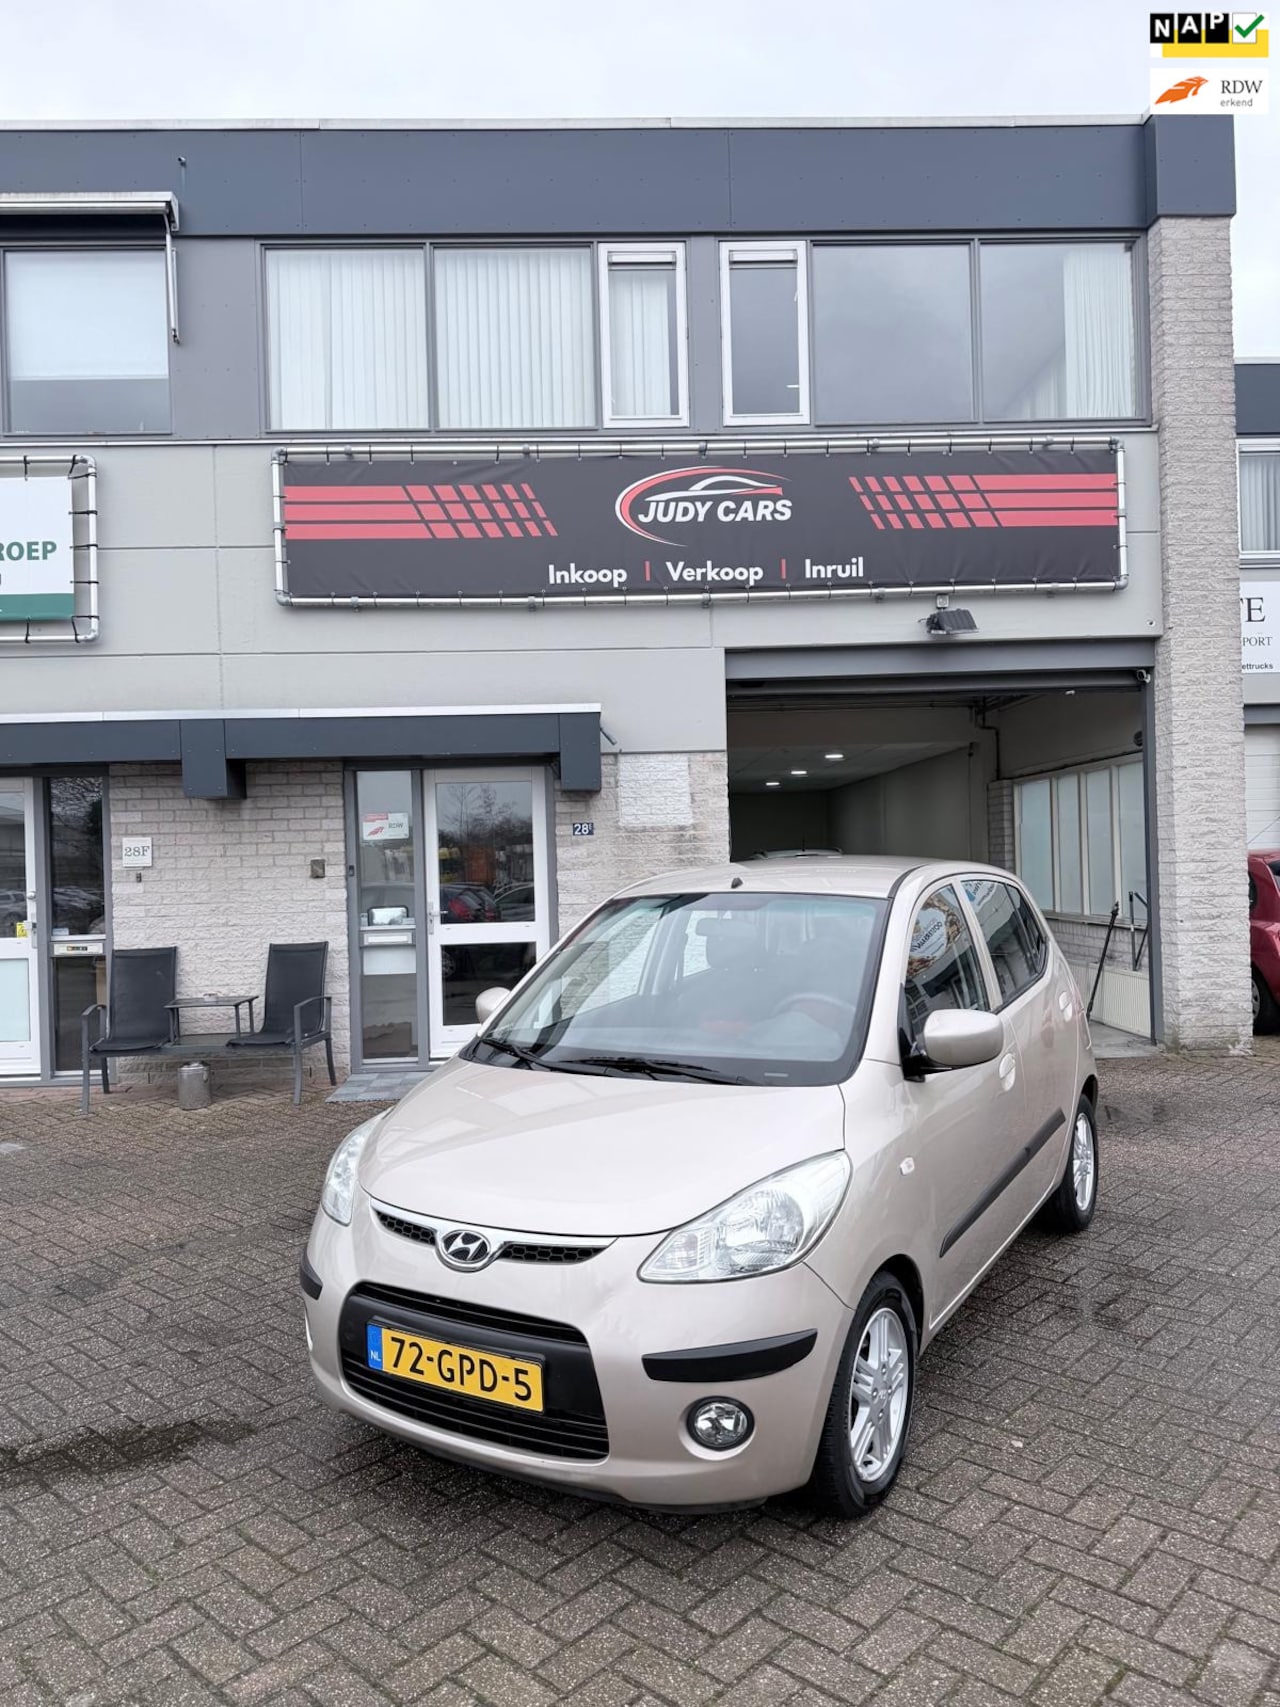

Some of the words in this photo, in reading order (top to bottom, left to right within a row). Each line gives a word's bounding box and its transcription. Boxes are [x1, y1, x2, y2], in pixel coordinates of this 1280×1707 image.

[638, 501, 713, 523] JUDY
[716, 500, 793, 522] CARS
[548, 562, 628, 588] Inkoop
[665, 560, 764, 586] Verkoop
[805, 556, 864, 579] Inruil
[1242, 636, 1273, 647] PORT
[124, 845, 150, 857] 28F
[370, 1350, 382, 1362] NL
[390, 1336, 532, 1401] 72-GPD-5
